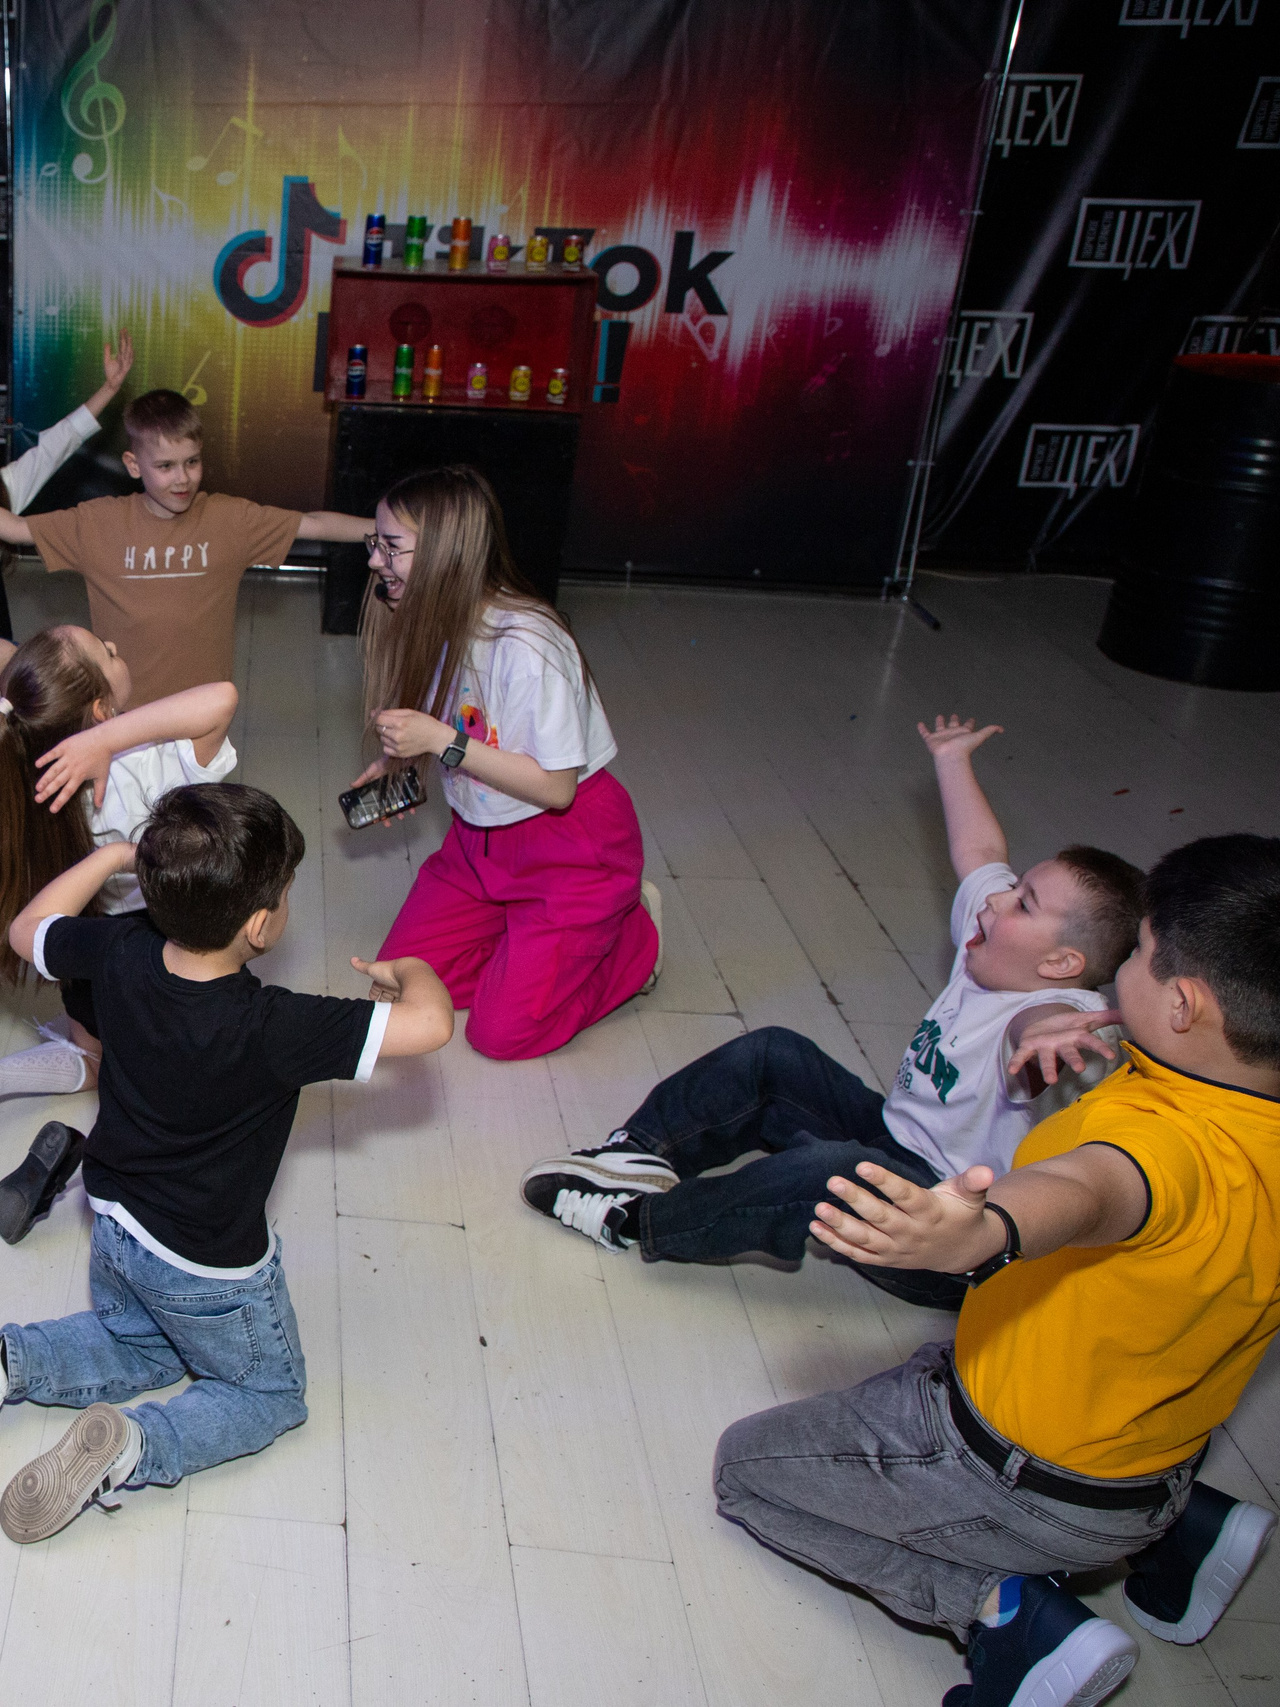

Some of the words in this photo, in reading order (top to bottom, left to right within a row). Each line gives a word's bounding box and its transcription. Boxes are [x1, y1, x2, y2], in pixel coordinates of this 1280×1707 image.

[1109, 208, 1189, 282] ЦЕХ
[1053, 433, 1128, 501] ЦЕХ
[123, 541, 210, 571] HAPPY
